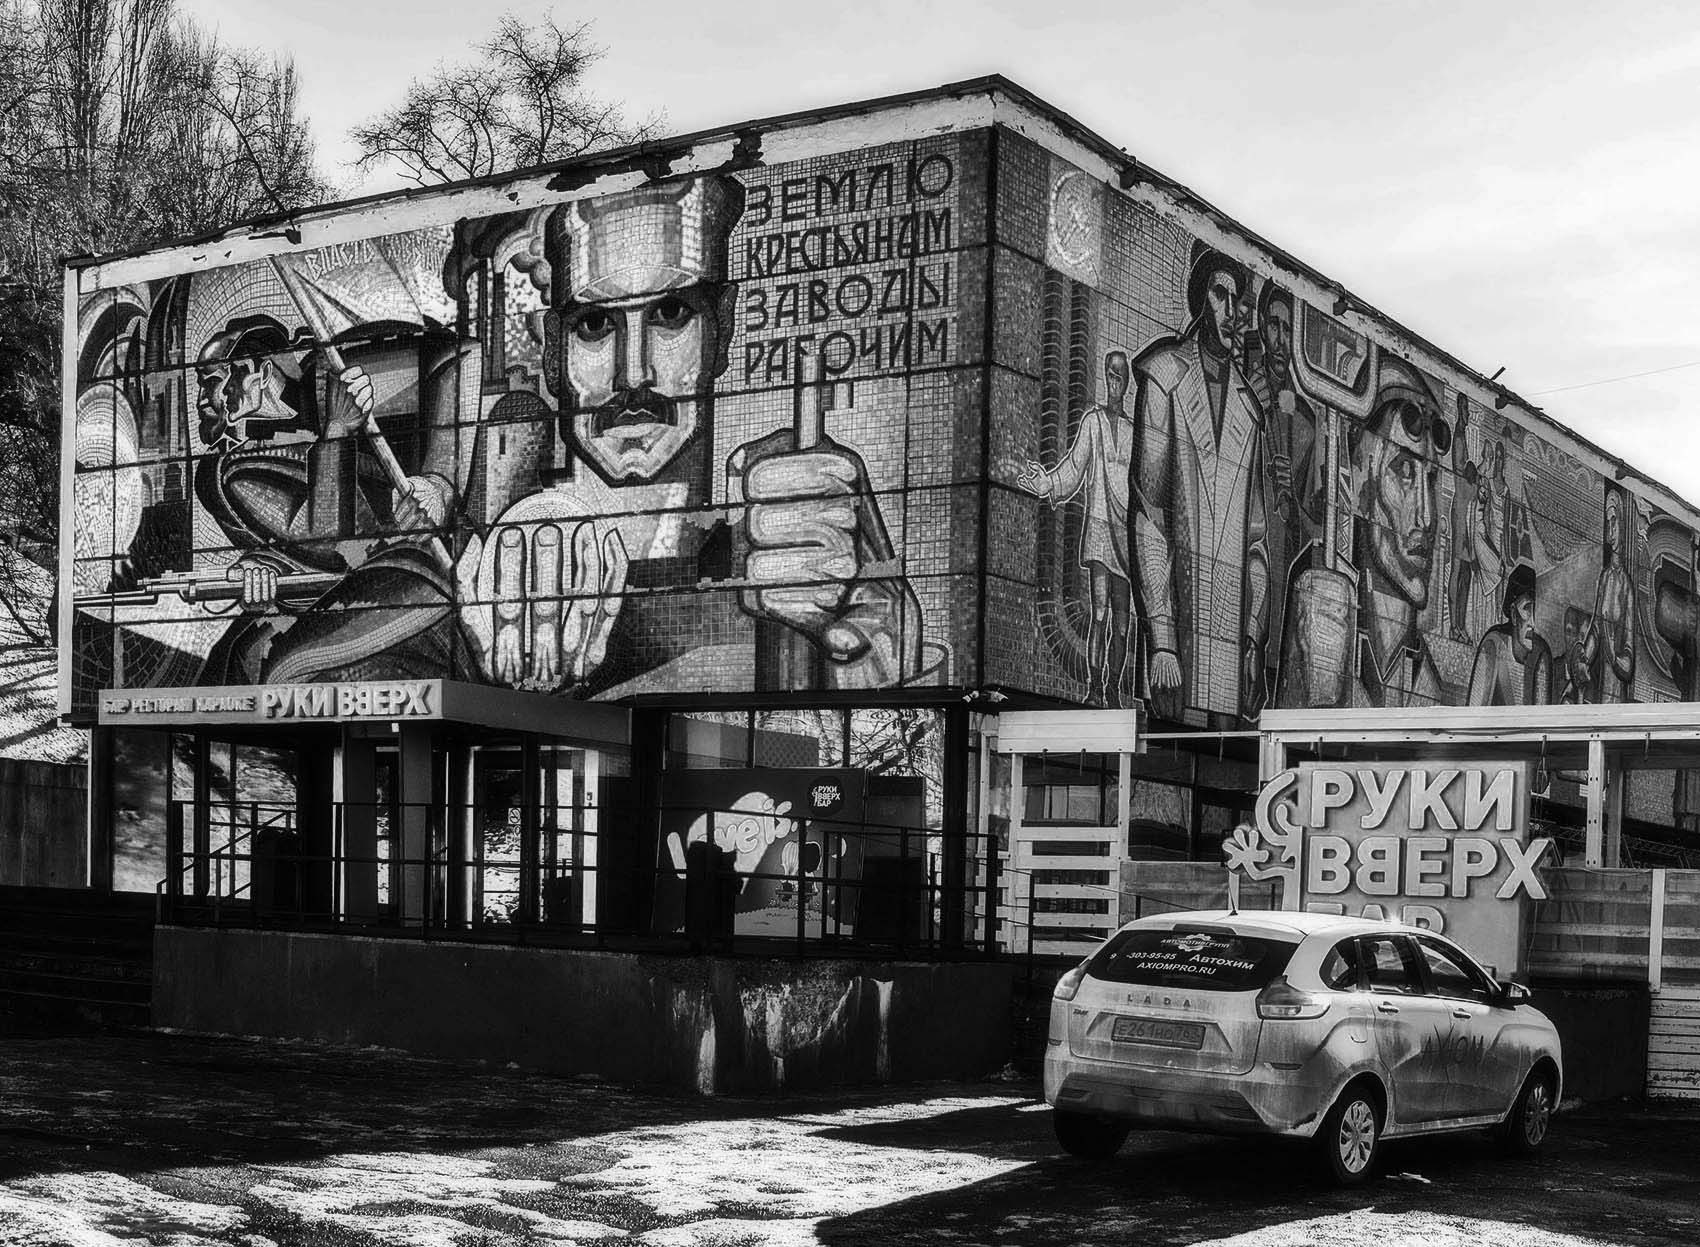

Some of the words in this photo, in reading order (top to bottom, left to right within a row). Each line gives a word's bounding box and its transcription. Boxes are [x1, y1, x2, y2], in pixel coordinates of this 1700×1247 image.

[746, 153, 954, 227] ЗЕМЛЮ
[746, 206, 951, 279] КРЕСТЬЯНАМ
[745, 261, 950, 332] ЗАВОДЫ
[262, 687, 337, 718] РУКИ
[818, 785, 838, 793] РУКИ
[1310, 769, 1516, 831] РУКИ
[1136, 961, 1217, 976] AXIOMPRO.RU
[1126, 993, 1192, 1009] LADA
